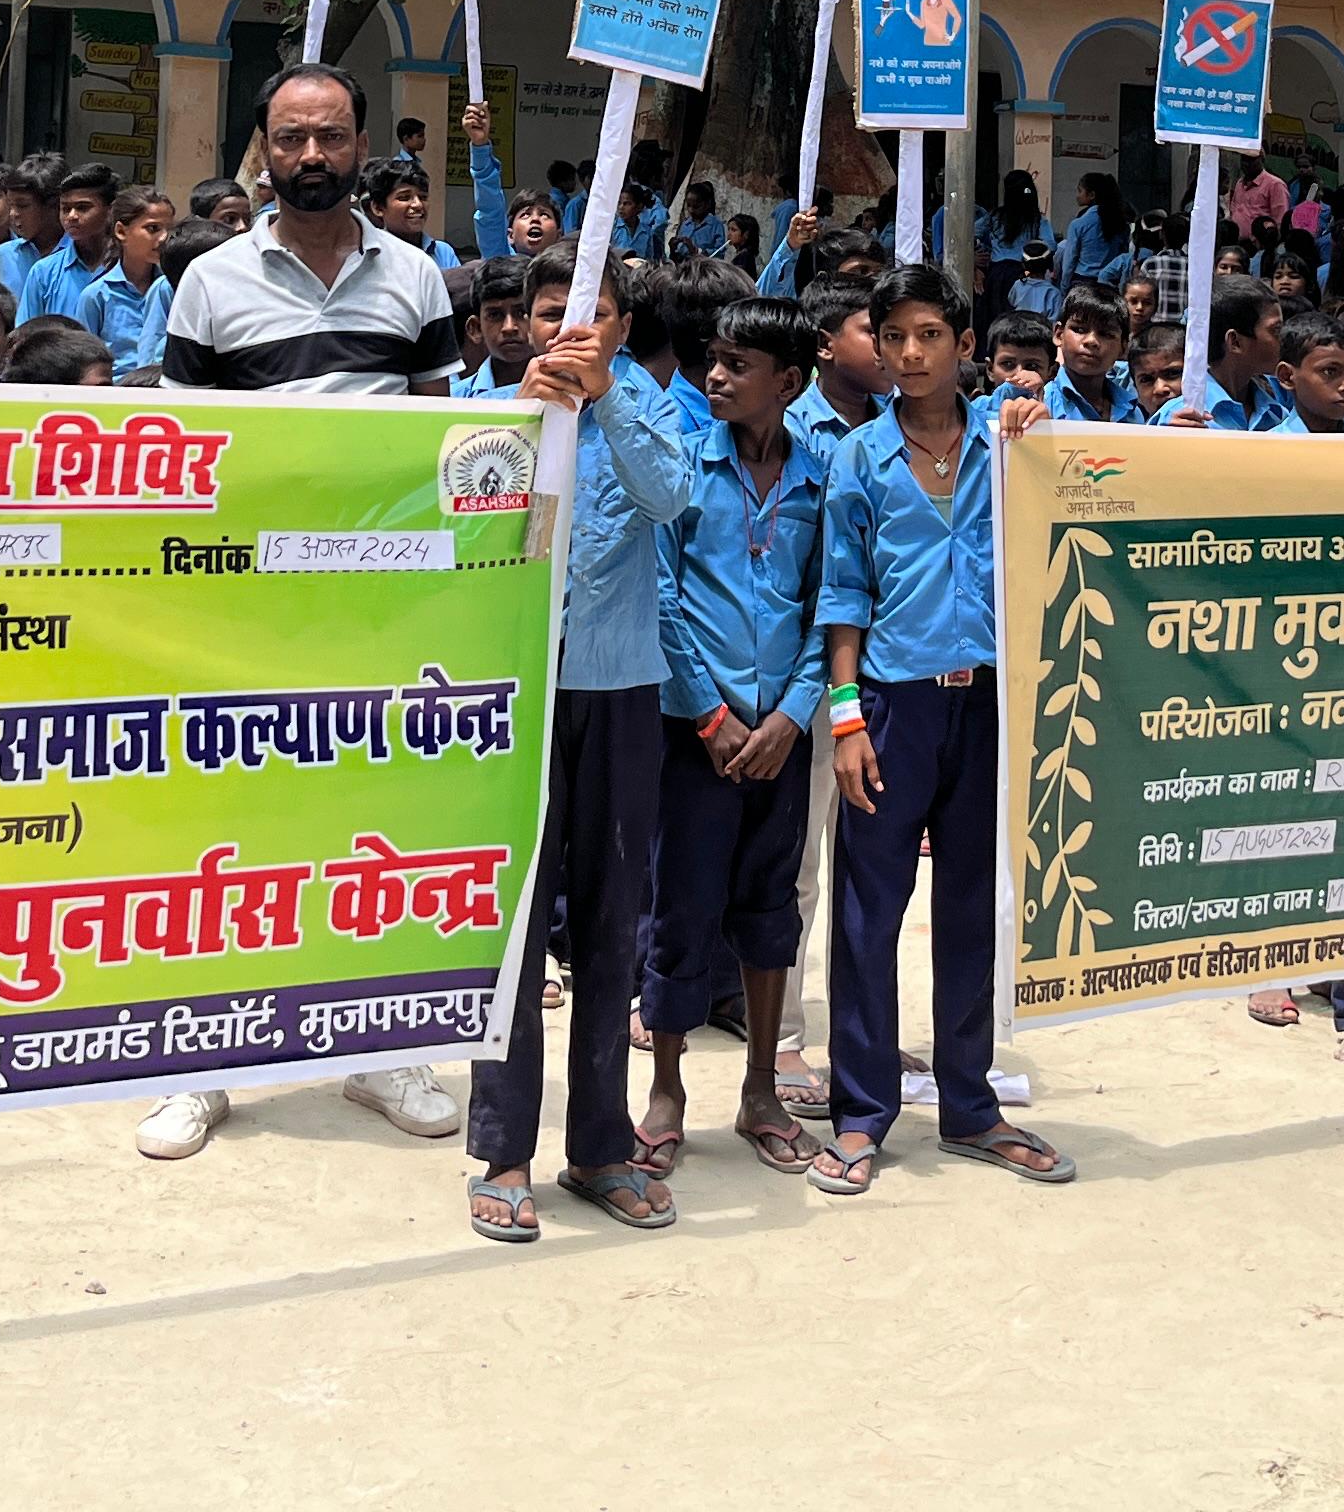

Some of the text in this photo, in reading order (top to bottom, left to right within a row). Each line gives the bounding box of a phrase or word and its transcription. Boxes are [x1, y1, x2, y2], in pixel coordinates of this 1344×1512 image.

[588, 3, 702, 40] इससे होंगे अनेक रोग
[685, 4, 708, 20] भोग
[89, 45, 136, 61] Sunday
[869, 57, 884, 68] नशे
[886, 57, 898, 68] को
[901, 60, 918, 68] अगर
[876, 72, 951, 87] कभी न सुख पाओगे
[519, 100, 537, 116] Every
[1016, 128, 1051, 145] Welcome
[34, 414, 230, 496] शिविर
[458, 496, 524, 511] ASAHSKK
[1067, 496, 1136, 519] अमृत महोत्सव
[160, 536, 254, 576] दिनांक
[263, 536, 290, 566] 15
[359, 537, 431, 563] 2024
[1127, 529, 1254, 569] सामाजिक
[1260, 536, 1323, 563] न्याय
[1146, 596, 1261, 655] नशा
[182, 689, 394, 771] कल्याण
[404, 666, 518, 759] केन्द्र
[1140, 696, 1272, 742] परियोजना
[1143, 768, 1301, 804] कार्यक्रम का नाम
[1139, 833, 1184, 867] तिथि
[1204, 828, 1234, 860] 15
[325, 833, 509, 935] केन्द्र
[1133, 889, 1313, 932] जिला/राज्य का नाम
[1015, 974, 1066, 1007] योजक
[1081, 953, 1175, 997] अल्पसंख्यक
[1178, 943, 1205, 980] एवं
[1206, 942, 1260, 978] हरिजन
[1264, 937, 1311, 970] समाज
[13, 1009, 152, 1071] डायमंड
[163, 996, 285, 1054] रिसॉर्ट,
